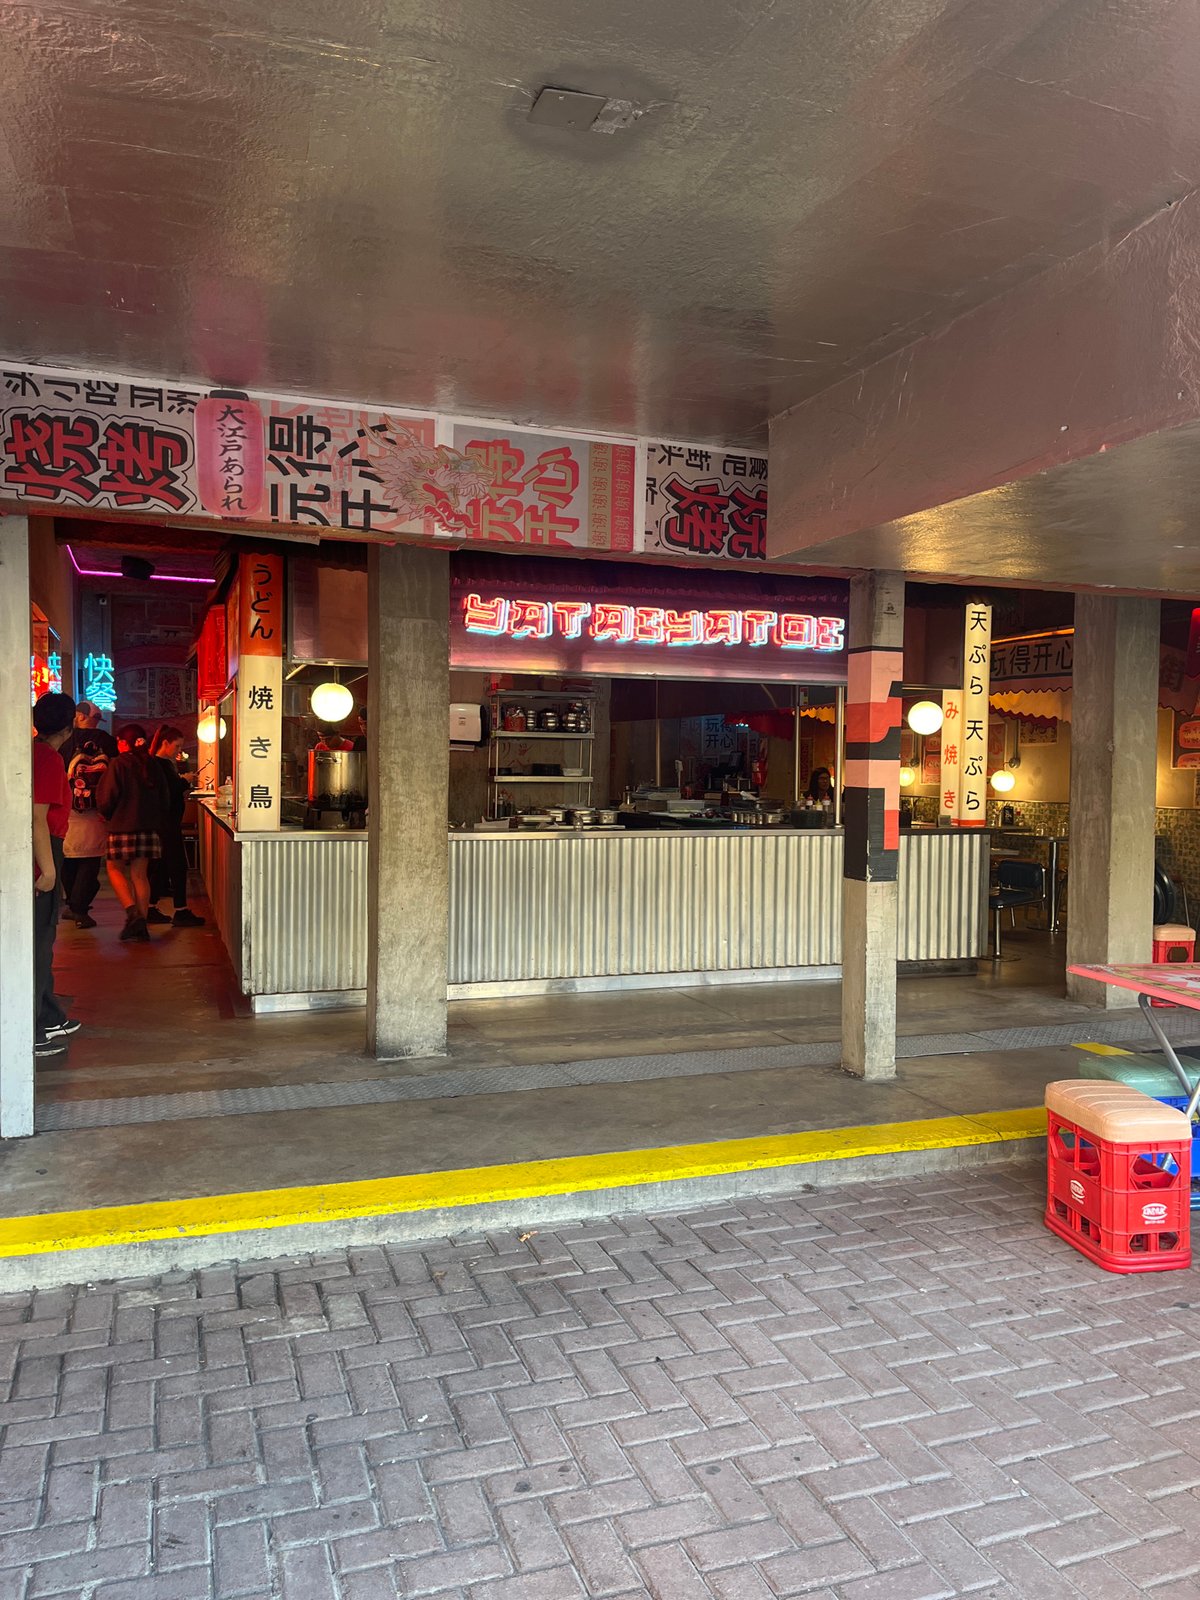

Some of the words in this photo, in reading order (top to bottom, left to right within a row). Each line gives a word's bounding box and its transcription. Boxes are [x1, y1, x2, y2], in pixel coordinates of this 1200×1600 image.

[4, 411, 193, 511] 烧烤
[219, 404, 249, 511] 大江戸あられ
[250, 563, 274, 640] うどん
[84, 652, 118, 713] 快餐
[968, 610, 987, 695] 天ぷら
[248, 685, 273, 809] 焼き鳥
[943, 701, 959, 810] み焼き
[964, 719, 984, 811] 天ぷら
